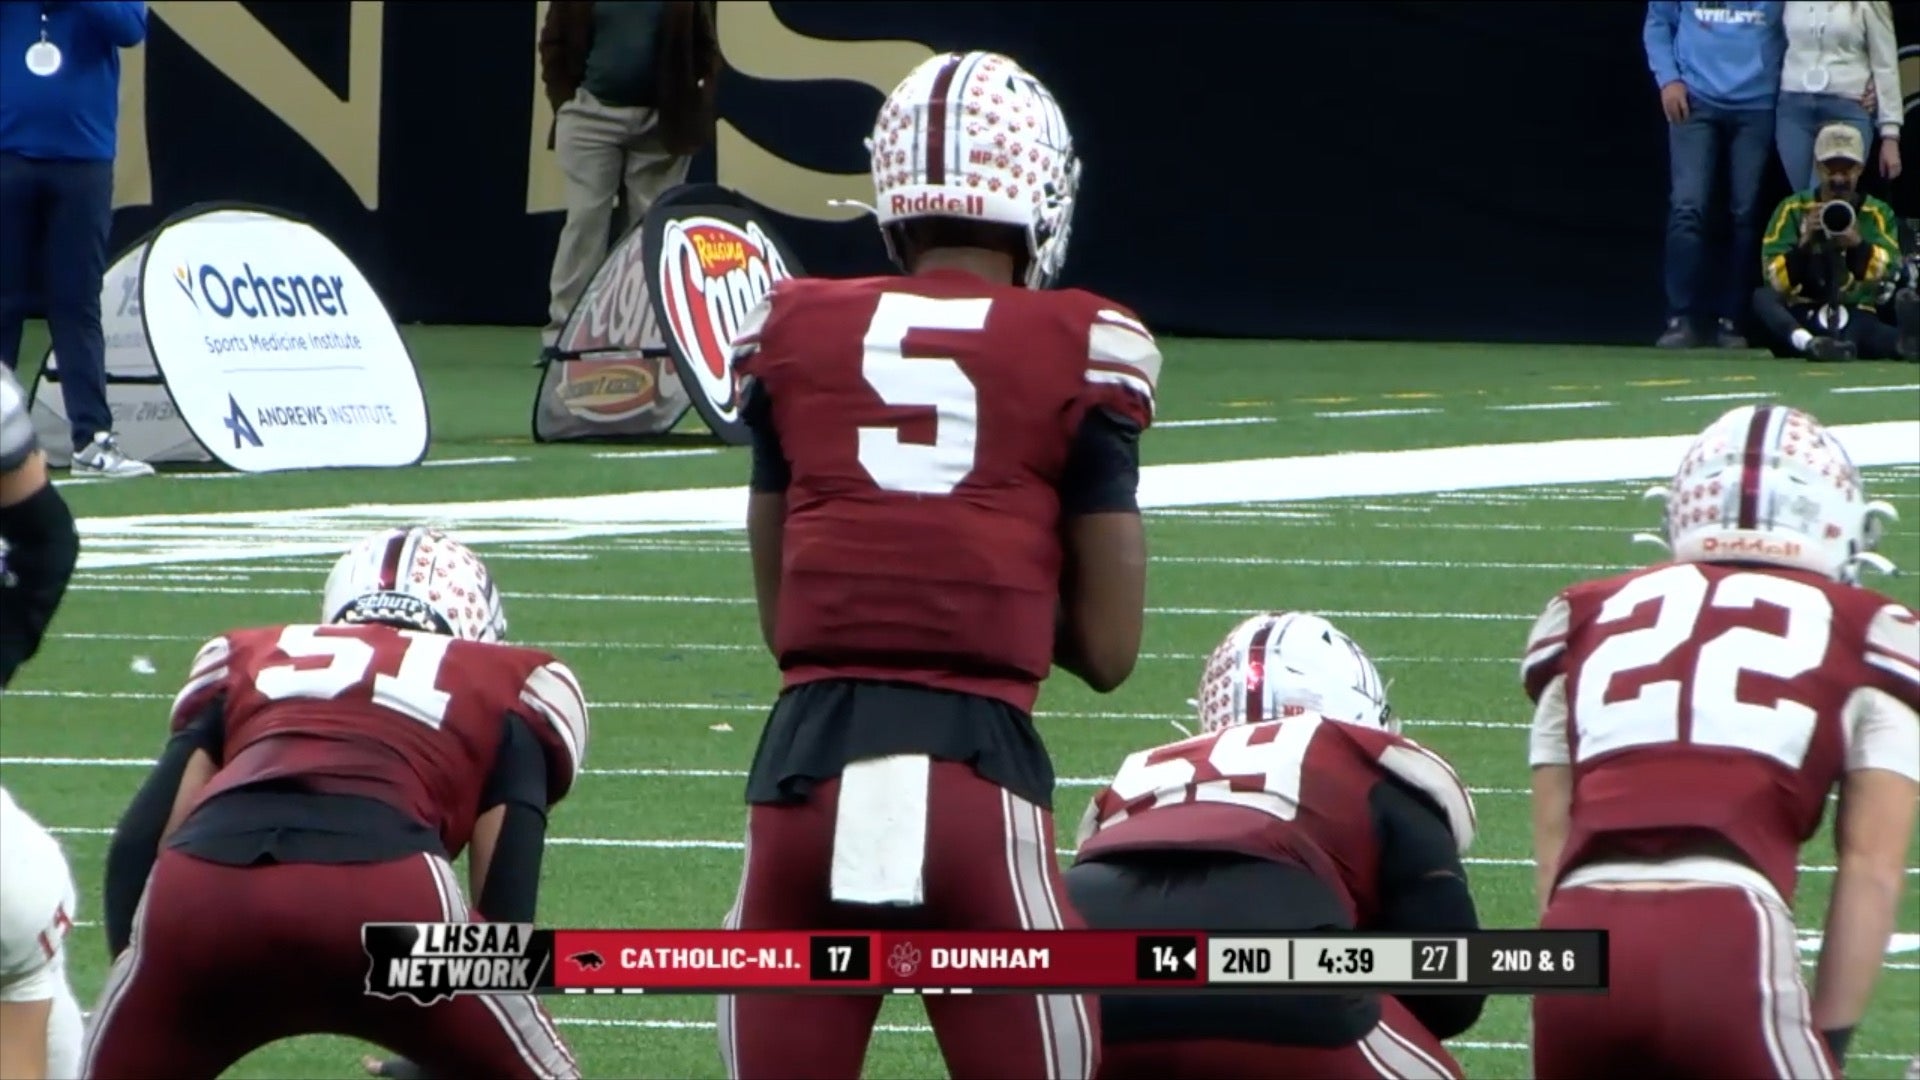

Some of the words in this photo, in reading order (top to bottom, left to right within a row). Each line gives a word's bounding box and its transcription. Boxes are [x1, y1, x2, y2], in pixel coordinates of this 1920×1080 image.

[891, 192, 984, 217] Riddell
[693, 234, 747, 270] Raising
[199, 262, 349, 318] Ochsner
[205, 335, 248, 355] Sports
[249, 332, 307, 352] Medicine
[308, 331, 362, 351] Institute
[257, 405, 328, 426] ANDREWS
[329, 404, 397, 425] INSTITUTE
[858, 292, 993, 494] 5
[255, 624, 452, 731] 51
[1575, 563, 1833, 769] 22
[1098, 714, 1324, 830] 59
